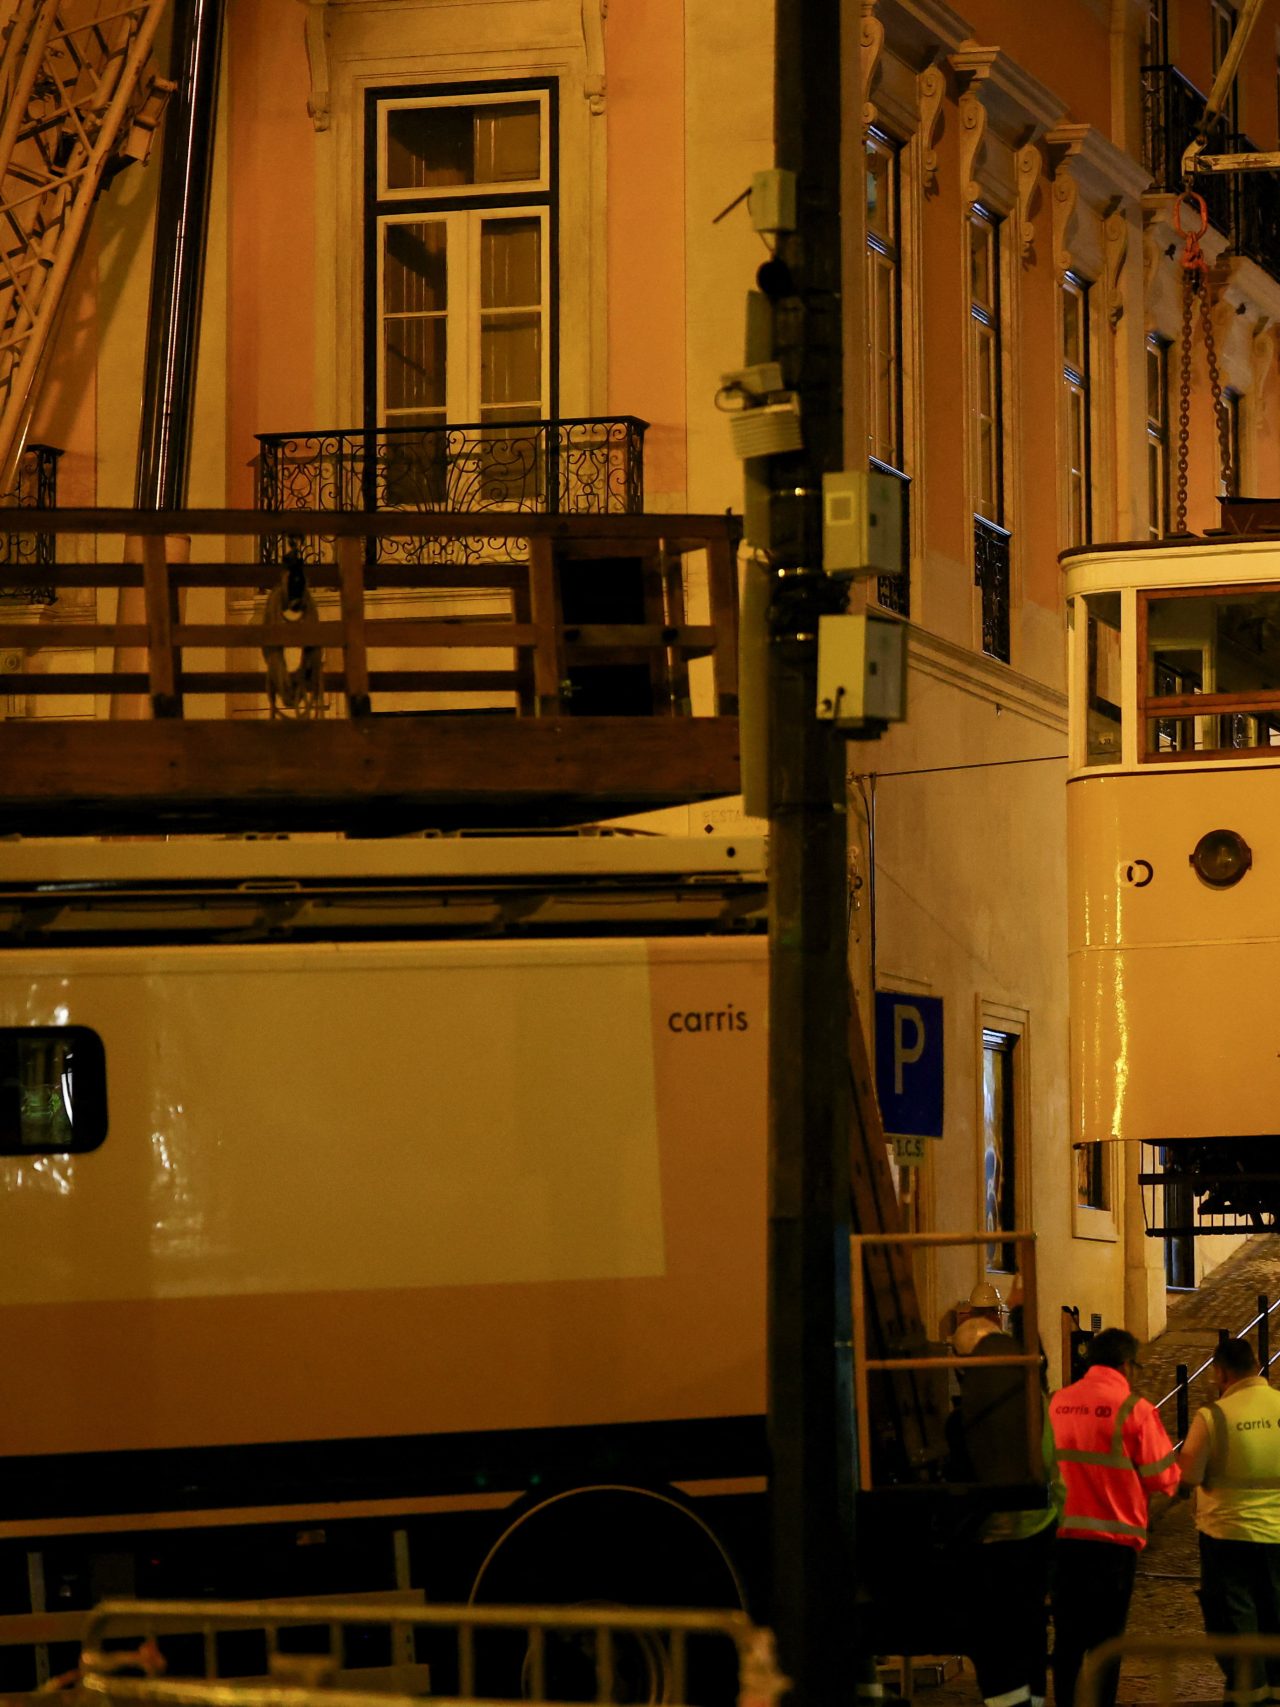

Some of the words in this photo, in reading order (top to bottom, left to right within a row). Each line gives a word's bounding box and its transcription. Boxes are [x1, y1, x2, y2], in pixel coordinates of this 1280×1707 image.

[667, 1003, 748, 1033] carris
[893, 1003, 926, 1096] P
[1055, 1405, 1089, 1415] carris
[1236, 1420, 1271, 1432] carris
